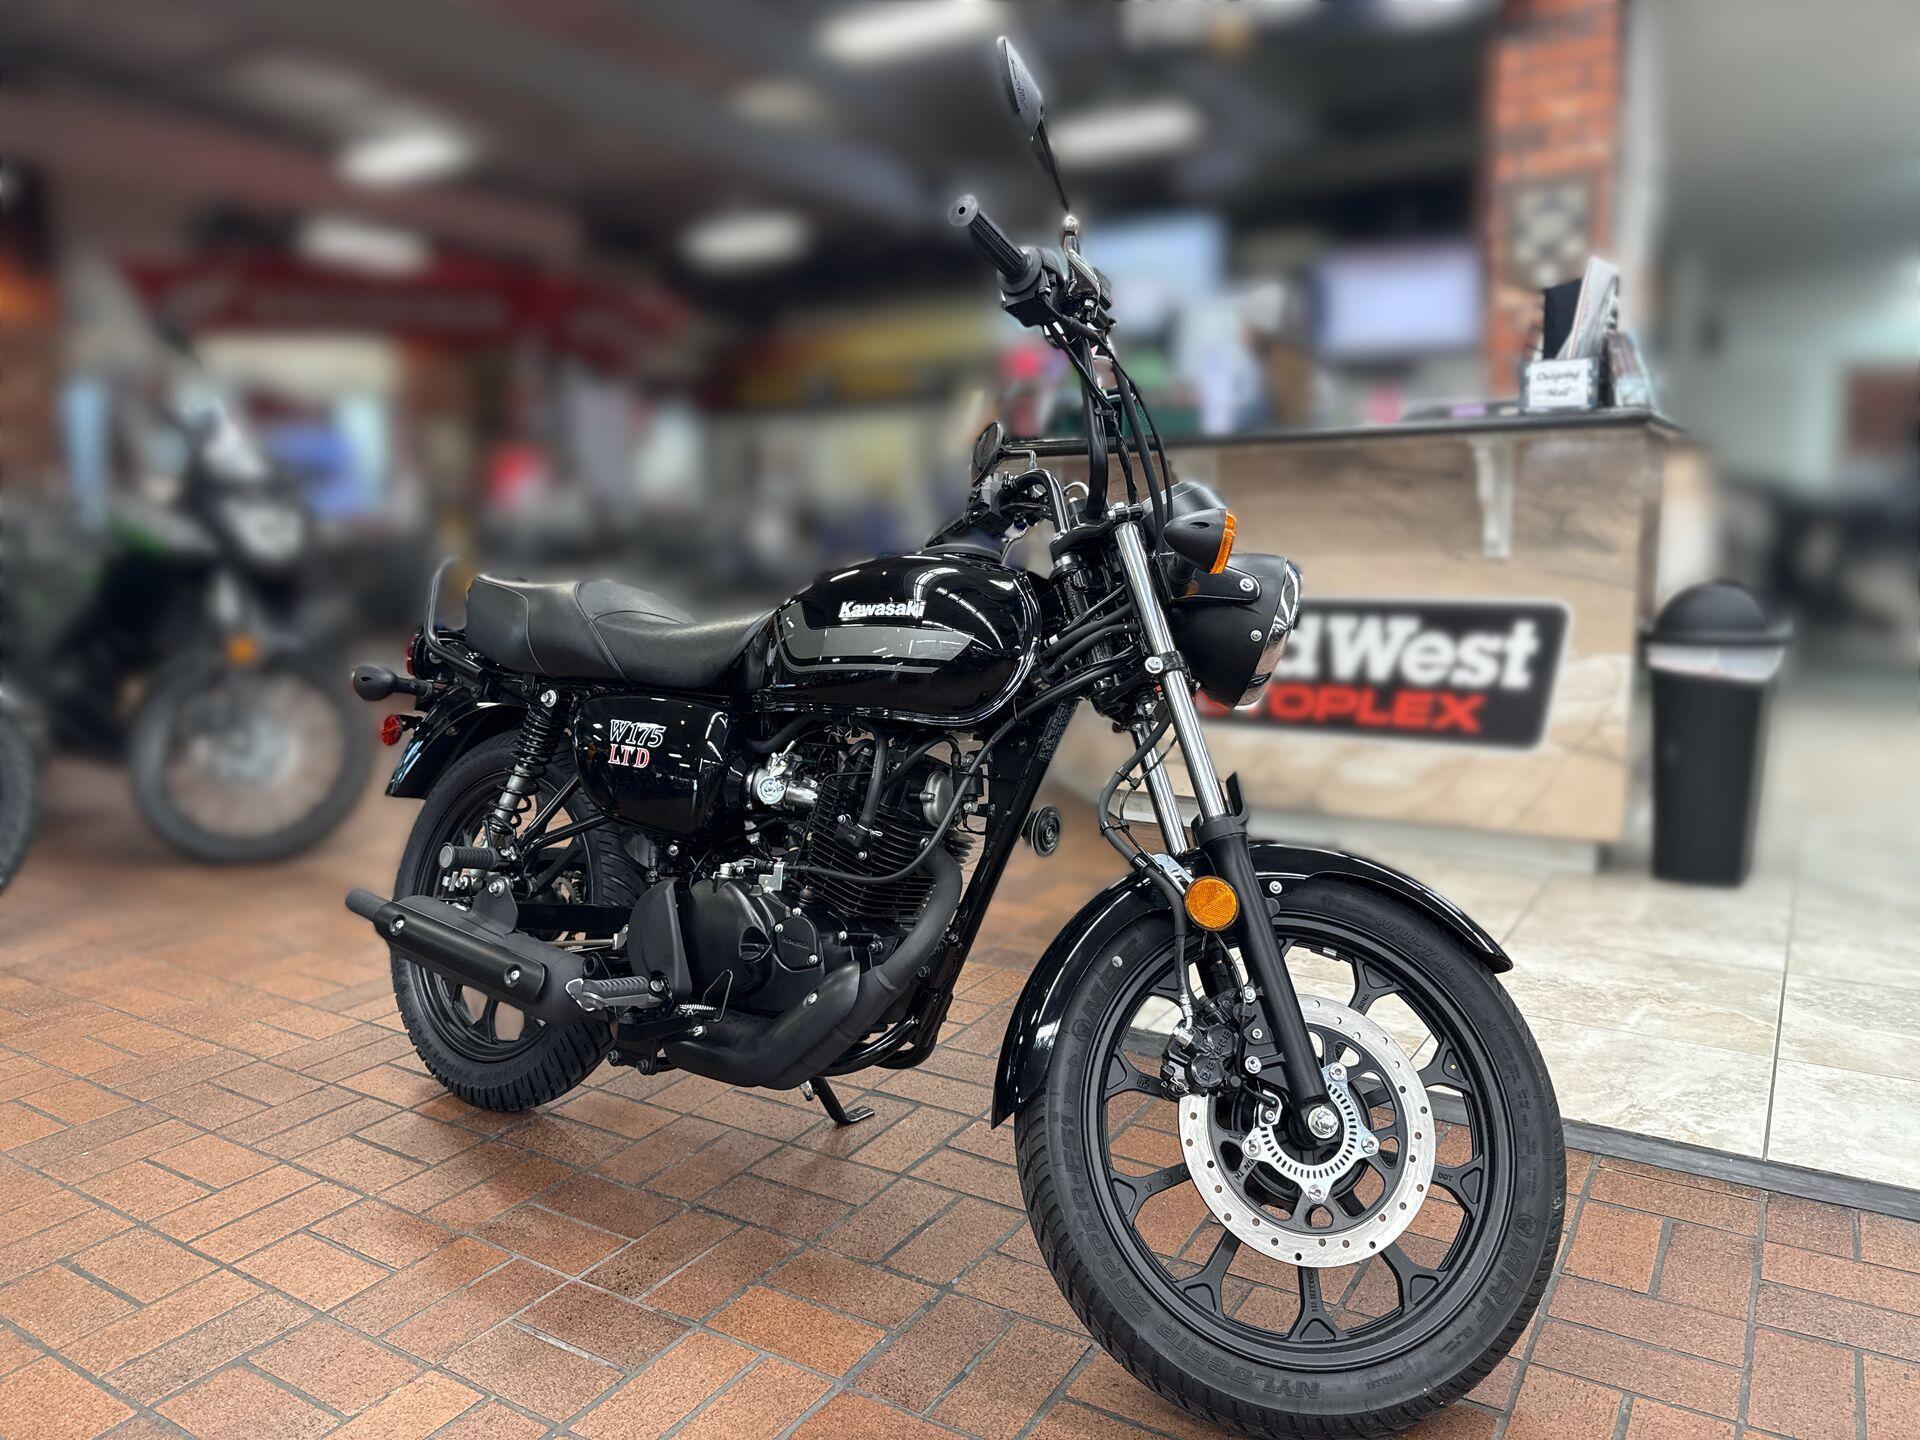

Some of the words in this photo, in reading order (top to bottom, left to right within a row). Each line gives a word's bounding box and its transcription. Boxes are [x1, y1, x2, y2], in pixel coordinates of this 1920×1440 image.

[838, 600, 926, 619] Kawasaki
[1275, 614, 1538, 687] dWest
[1196, 684, 1485, 732] OPLEX
[609, 718, 667, 748] W175
[607, 743, 651, 769] LTD
[1475, 1237, 1529, 1331] MRF
